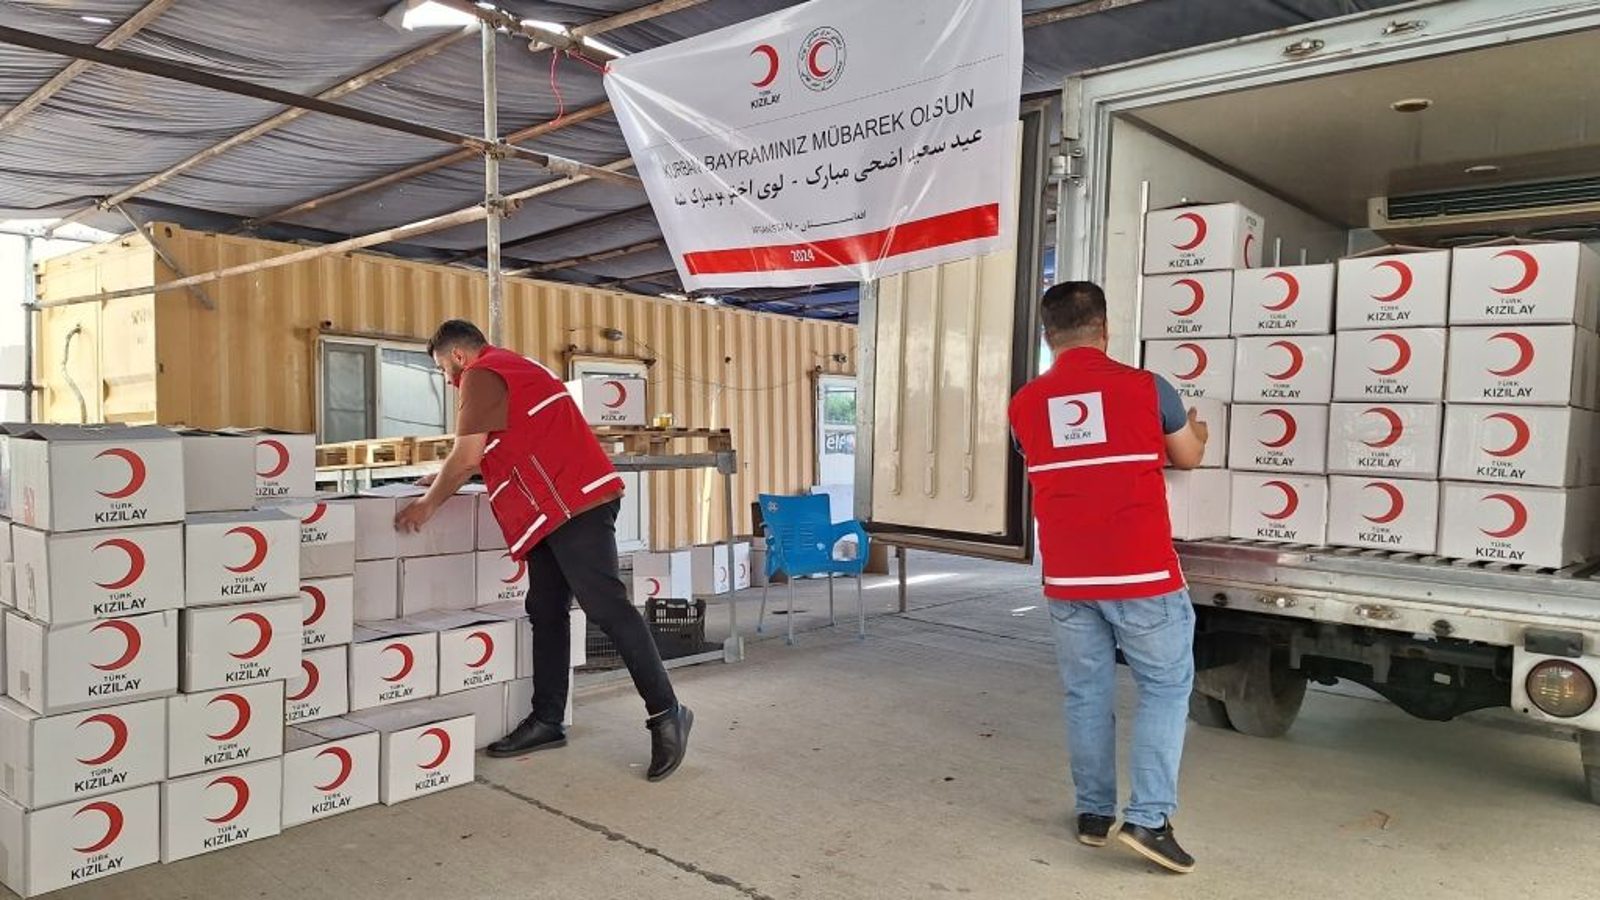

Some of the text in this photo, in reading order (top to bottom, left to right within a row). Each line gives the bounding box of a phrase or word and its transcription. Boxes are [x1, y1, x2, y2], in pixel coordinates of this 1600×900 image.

[704, 136, 808, 171] BAYRAMINIZ
[812, 111, 905, 151] MÜBAREK
[910, 88, 974, 127] OLSUN
[790, 249, 815, 262] 2024
[1169, 258, 1205, 268] KIZILAY
[1368, 311, 1410, 321] KIZILAY
[1486, 305, 1535, 315] KIZILAY
[1167, 325, 1202, 334] KIZILAY
[1259, 320, 1297, 328] KIZILAY
[1262, 389, 1300, 398] KIZILAY
[1365, 385, 1408, 394] KIZILAY
[1484, 388, 1532, 397] KIZILAY
[1256, 456, 1294, 466] KIZILAY
[1358, 458, 1401, 467] KIZILAY
[1477, 467, 1525, 479] KIZILAY
[95, 508, 148, 522] KIZILAY
[301, 532, 327, 542] ZILAY
[1258, 528, 1297, 539] KIZILAY
[1359, 532, 1402, 544] KIZILAY
[1476, 547, 1525, 560] KIZILAY
[221, 582, 267, 596] KIZILAY
[110, 592, 132, 600] TÜRK
[94, 598, 146, 614] KIZILAY
[302, 634, 325, 645] ILAY
[104, 674, 127, 682] TÜRK
[226, 666, 270, 682] KIZILAY
[88, 679, 140, 696] KIZILAY
[380, 688, 413, 702] KIZILAY
[204, 748, 250, 764] KIZILAY
[74, 772, 128, 792] KIZILAY
[416, 774, 450, 790] KIZILAY
[312, 797, 352, 813] KIZILAY
[204, 828, 249, 848] KIZILAY
[71, 856, 123, 880] KIZILAY
